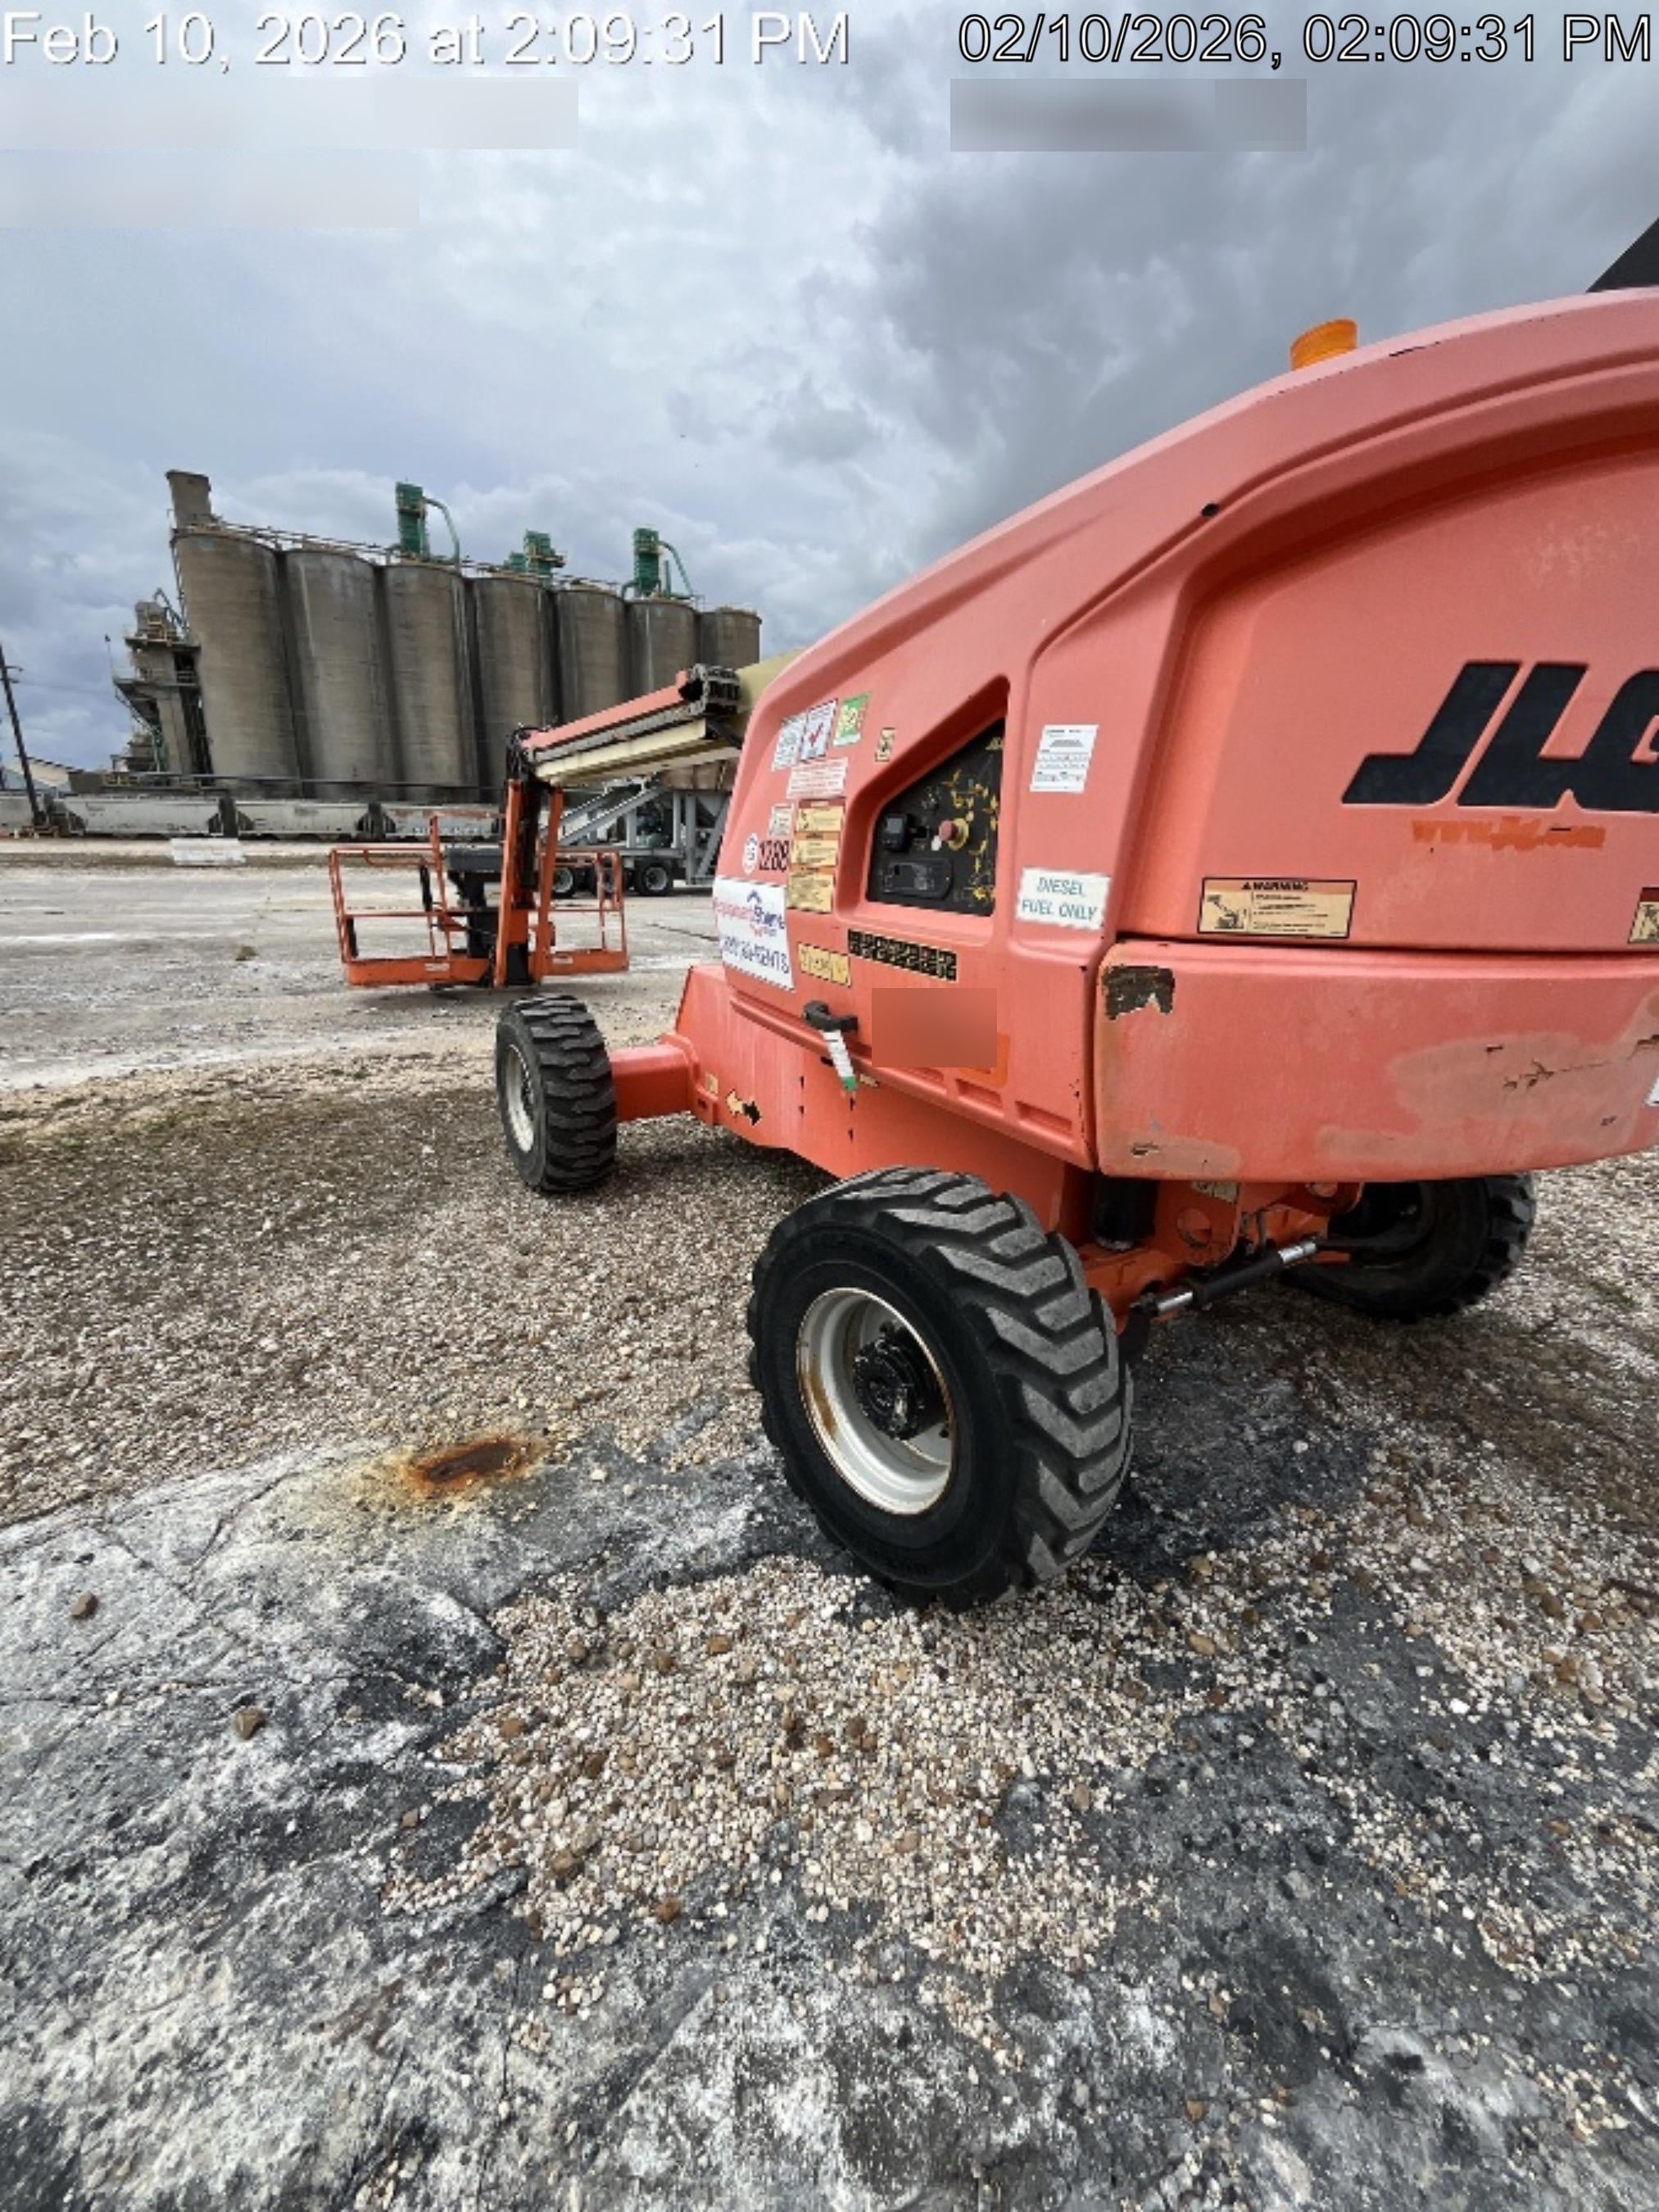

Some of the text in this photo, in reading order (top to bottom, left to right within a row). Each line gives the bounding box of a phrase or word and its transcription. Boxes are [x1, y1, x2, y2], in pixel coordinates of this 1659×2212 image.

[1036, 877, 1087, 897] DIESEL
[1022, 898, 1099, 921] FUEL ONLY
